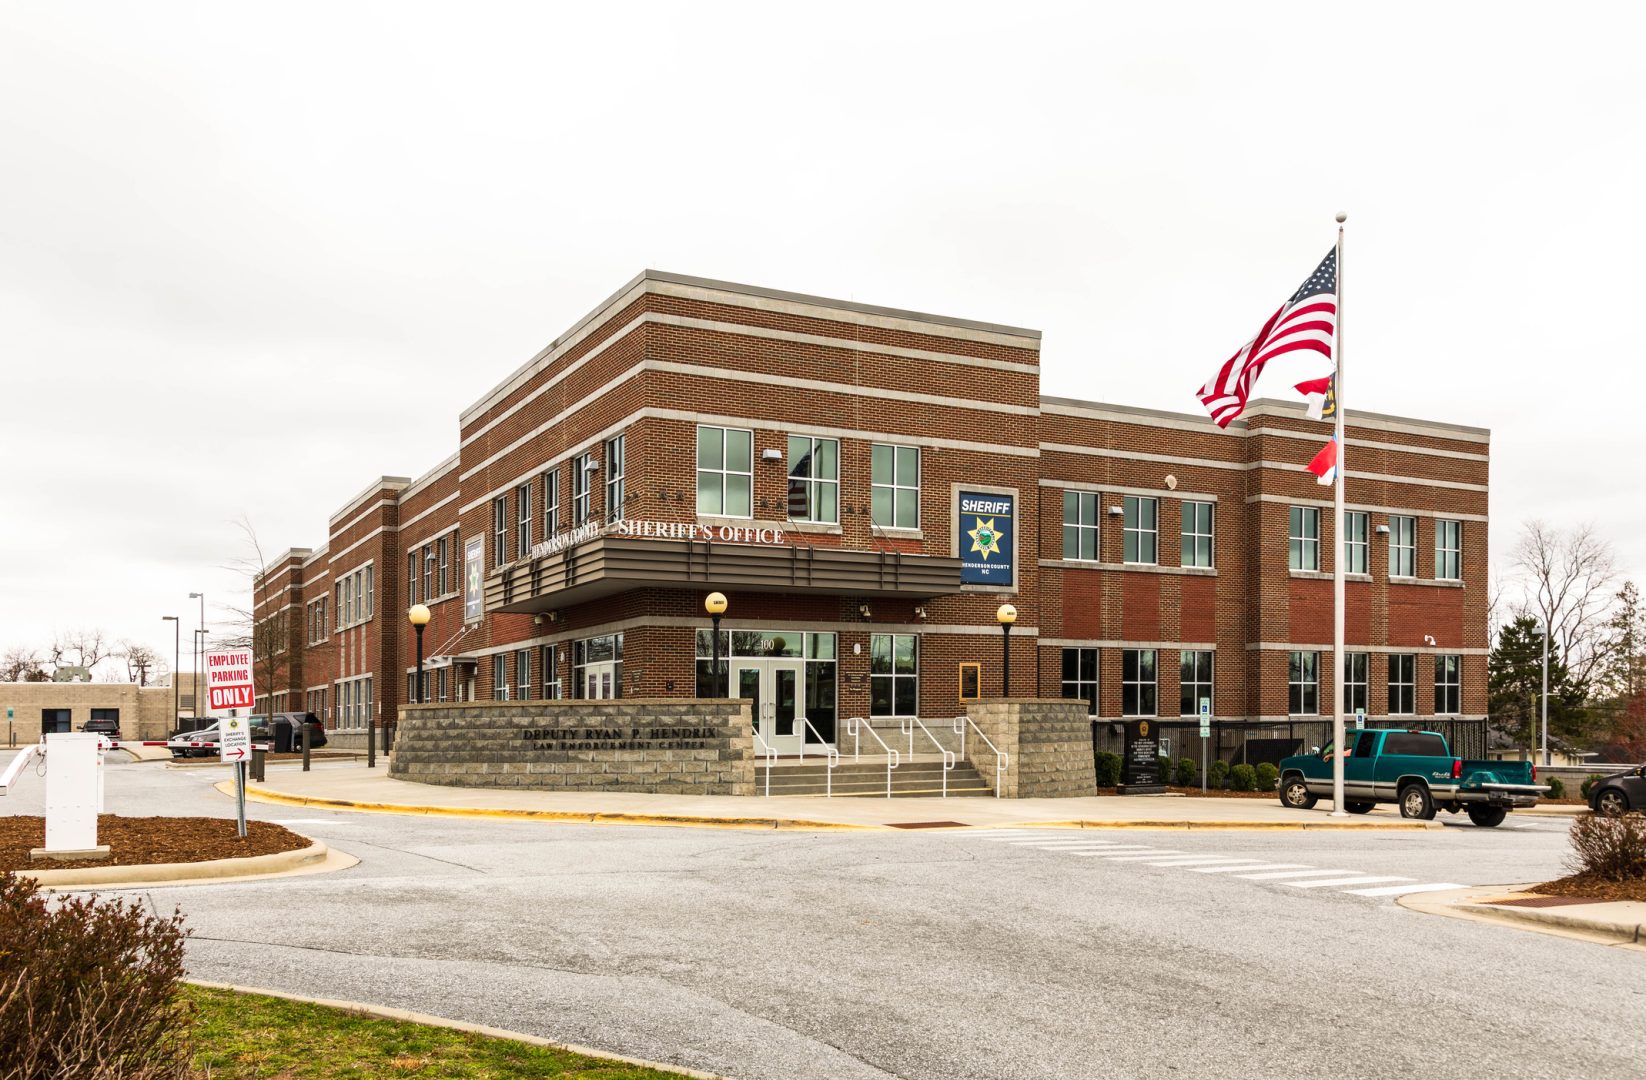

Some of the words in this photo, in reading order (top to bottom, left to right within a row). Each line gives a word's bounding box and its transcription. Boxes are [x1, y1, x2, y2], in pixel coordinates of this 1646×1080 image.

[961, 500, 1010, 514] SHERIFF
[618, 519, 713, 540] SHERIFF'S
[719, 526, 784, 544] OFFICE
[760, 640, 774, 650] 100
[209, 654, 248, 666] EMPLOYEE
[212, 669, 248, 682] PARKING
[212, 687, 250, 706] ONLY
[523, 729, 577, 740] DEPUTY
[585, 729, 622, 739] RYAN
[632, 728, 642, 739] P.
[650, 728, 716, 739] HENDRIX
[533, 742, 554, 750] LAW
[561, 741, 651, 750] ENFORCEMENT
[658, 741, 705, 749] CENTER
